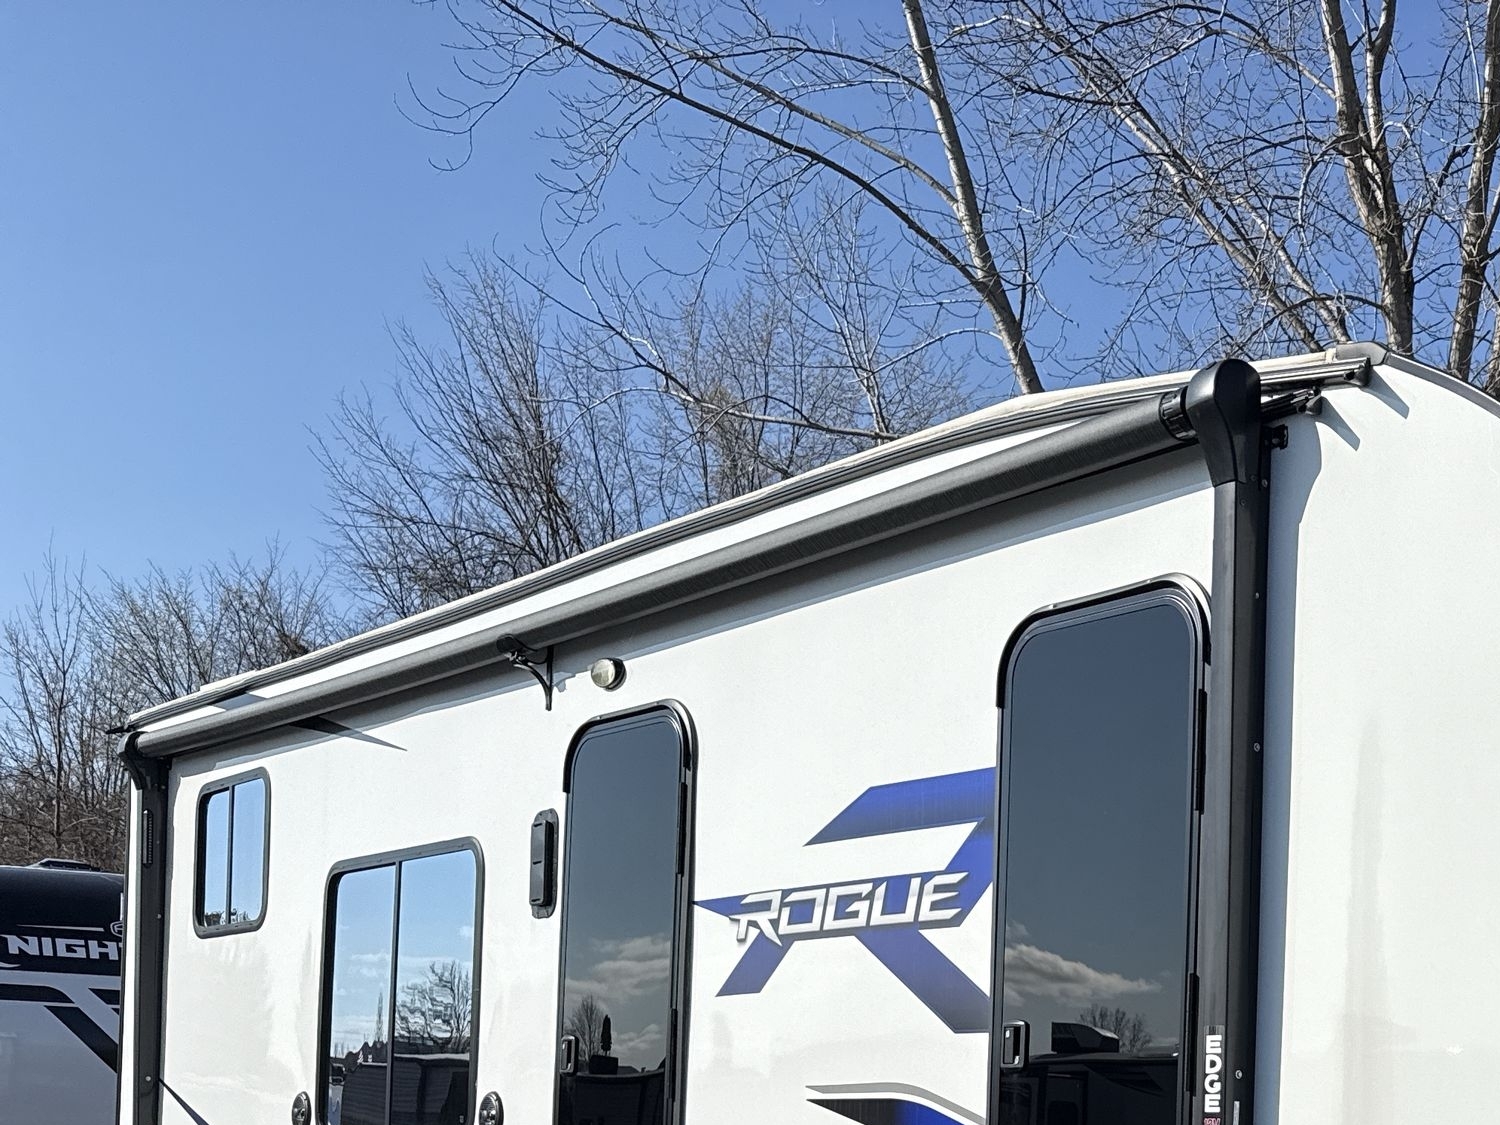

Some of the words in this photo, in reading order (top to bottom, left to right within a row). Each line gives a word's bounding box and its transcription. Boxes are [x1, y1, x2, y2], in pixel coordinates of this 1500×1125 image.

[729, 872, 969, 946] ROGUE
[0, 934, 122, 960] NIGH
[1204, 1035, 1223, 1113] EDGE
